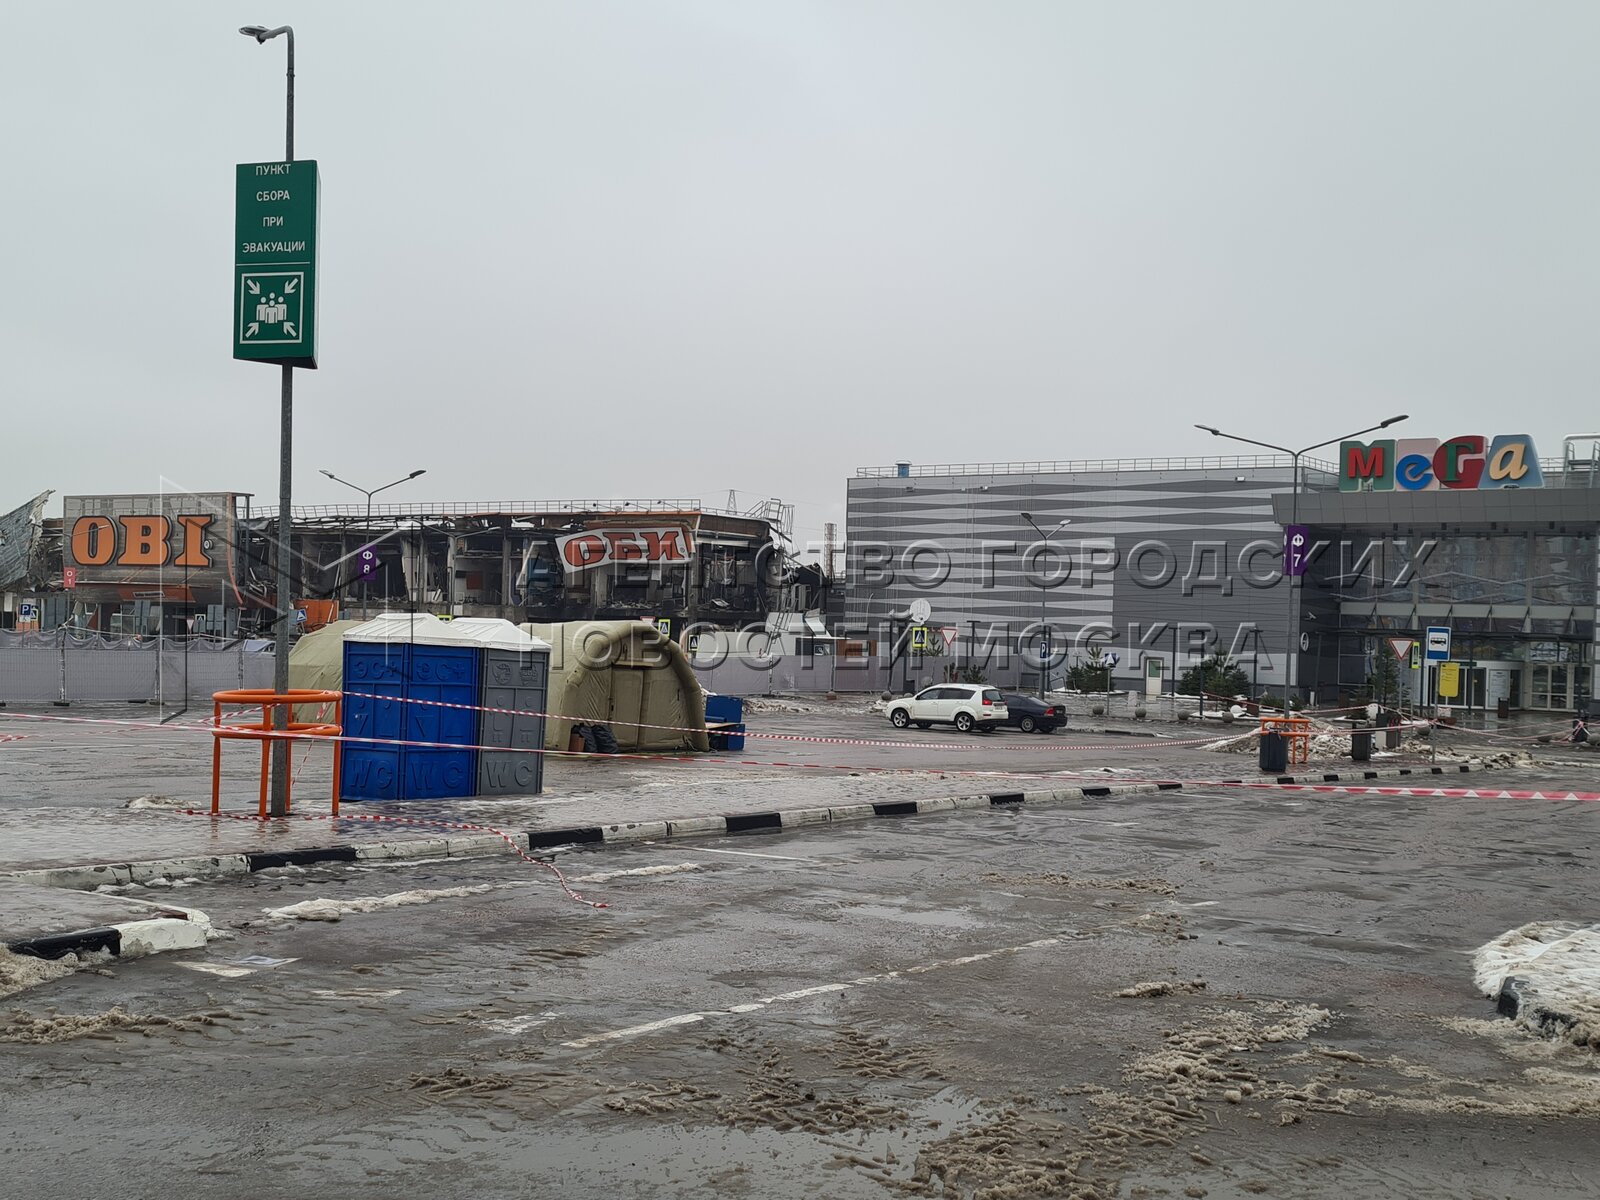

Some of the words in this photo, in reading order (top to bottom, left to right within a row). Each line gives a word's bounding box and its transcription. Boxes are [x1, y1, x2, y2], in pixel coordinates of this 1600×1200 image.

[256, 163, 291, 176] ПУНКТ
[256, 190, 290, 202] СБОРА
[263, 216, 284, 227] ПРИ
[242, 241, 305, 254] ЭВАКУАЦИИ
[71, 513, 215, 567] OBI
[1292, 534, 1304, 547] Ф
[564, 530, 686, 567] ОБИ
[362, 551, 373, 560] Ф
[1294, 553, 1301, 567] 7
[363, 564, 370, 574] 8
[22, 605, 30, 615] P
[1041, 643, 1046, 658] P
[349, 758, 393, 789] WC
[411, 760, 464, 791] WC
[485, 759, 533, 789] WC
